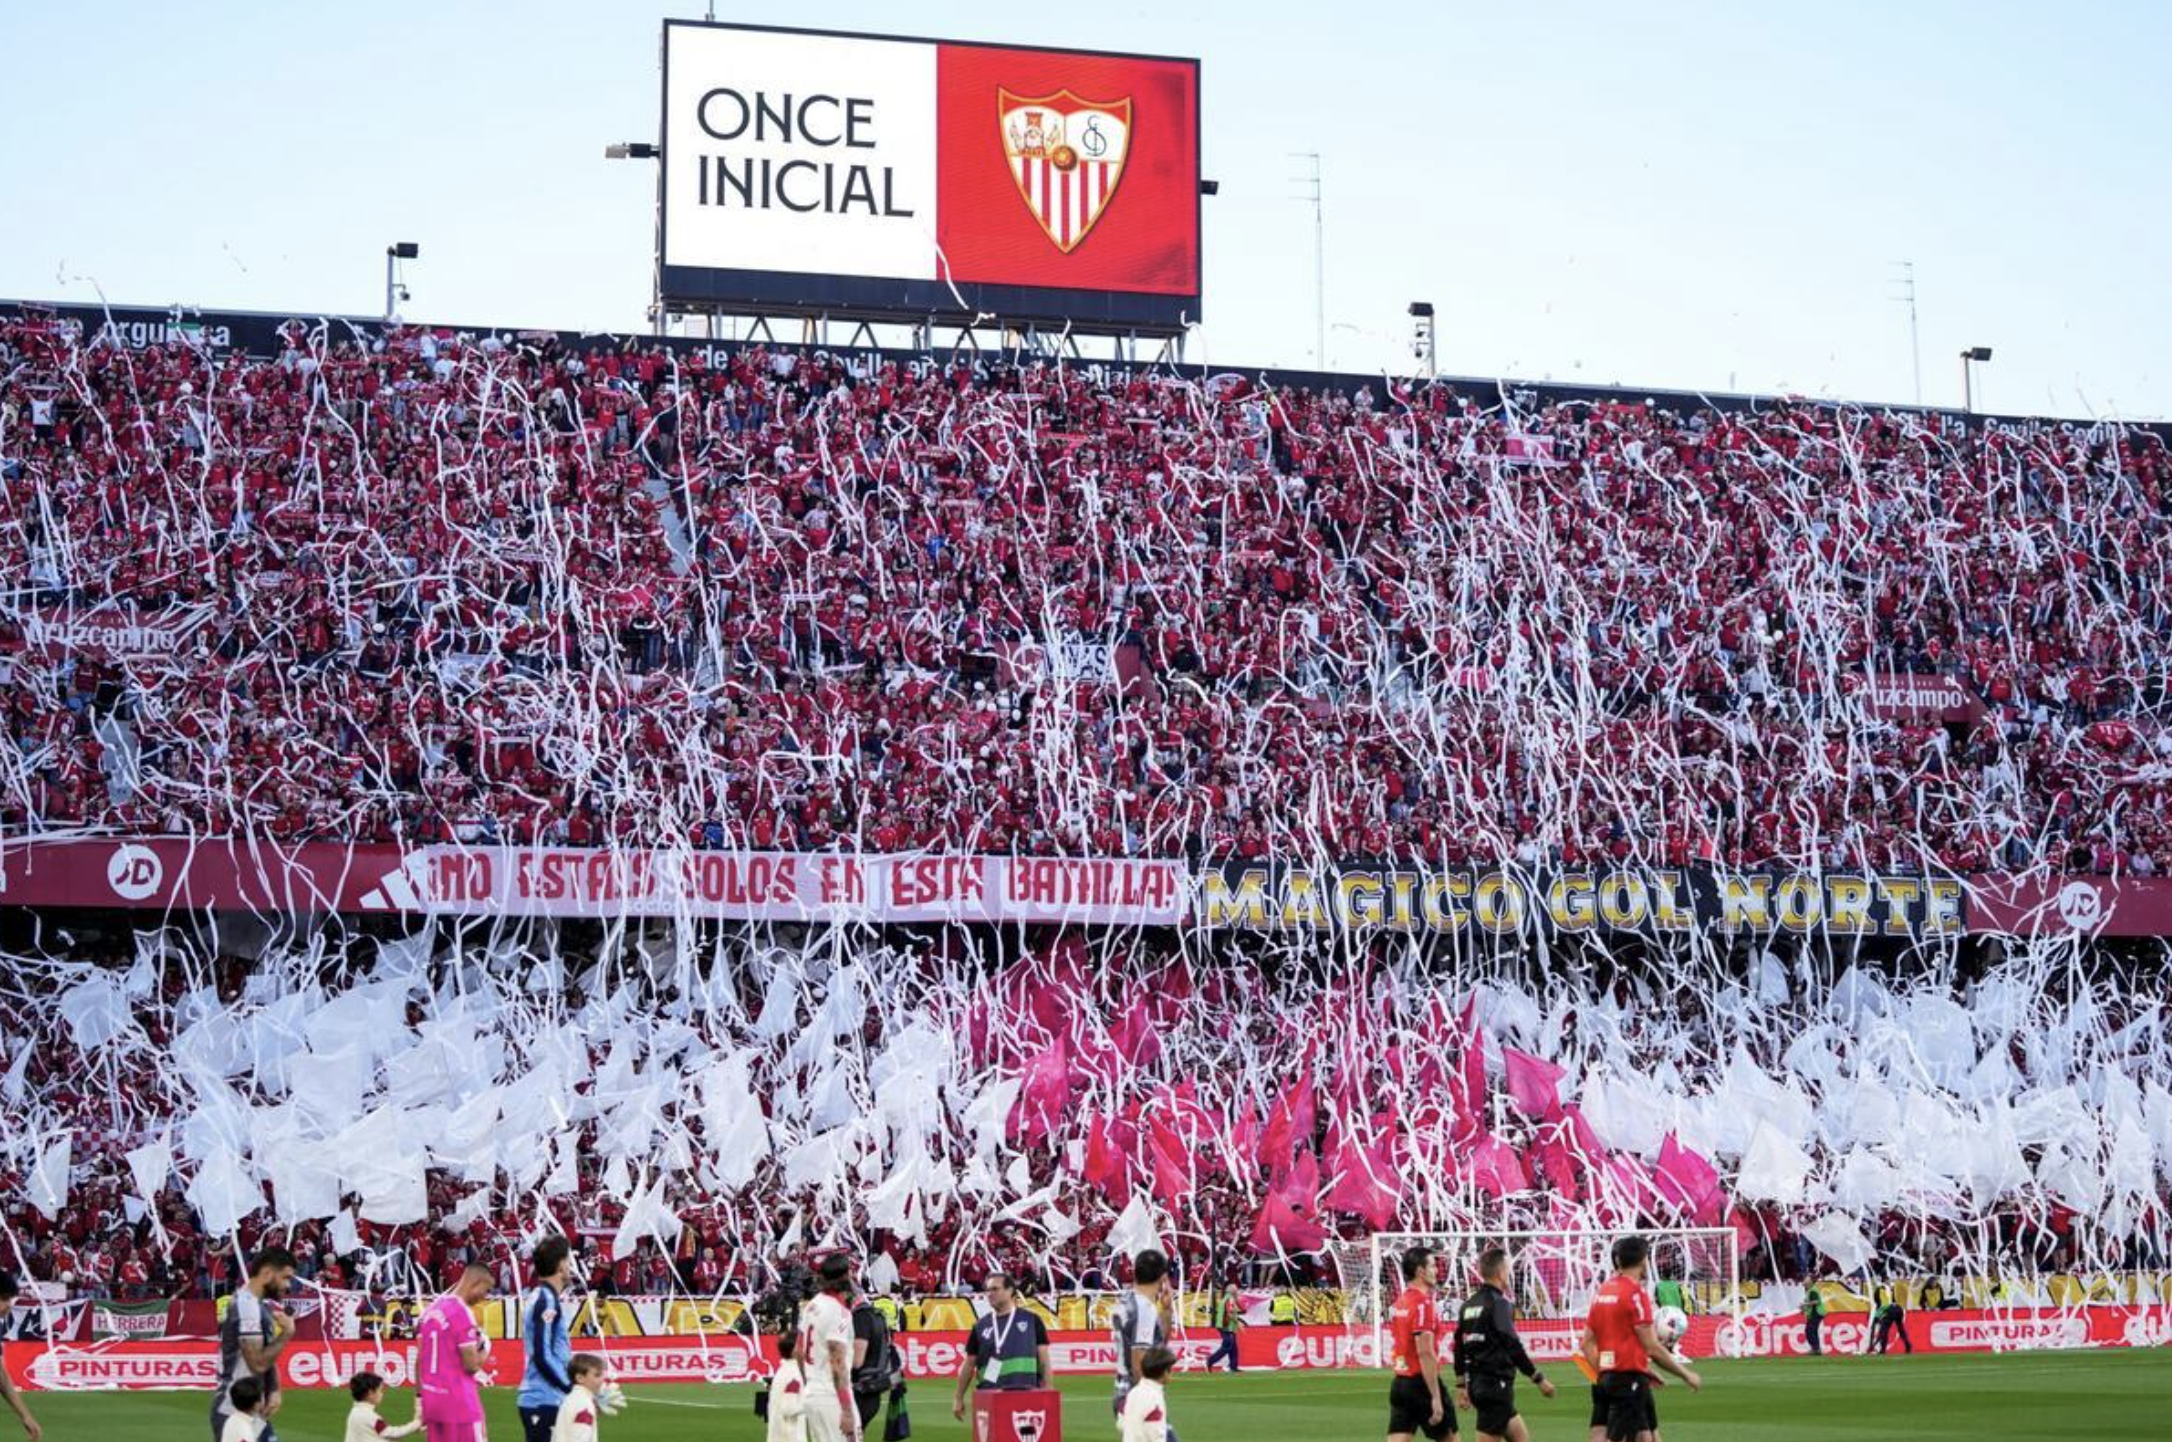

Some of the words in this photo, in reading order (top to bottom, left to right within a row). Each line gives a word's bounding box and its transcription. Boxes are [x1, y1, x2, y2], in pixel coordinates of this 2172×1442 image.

[697, 87, 876, 149] ONCE
[698, 154, 914, 218] INICIAL
[1874, 687, 1963, 709] uzcampo
[115, 857, 155, 885] JD
[516, 849, 655, 900] ESTÁS
[821, 857, 864, 904] EN
[892, 856, 984, 907] ESTA
[1200, 870, 1528, 932] MAGICO
[1550, 870, 1694, 934] GOL
[1718, 872, 1964, 936] NORTE
[60, 1359, 217, 1378] PINTURAS
[609, 1354, 727, 1371] NTURAS
[429, 1330, 439, 1375] 1
